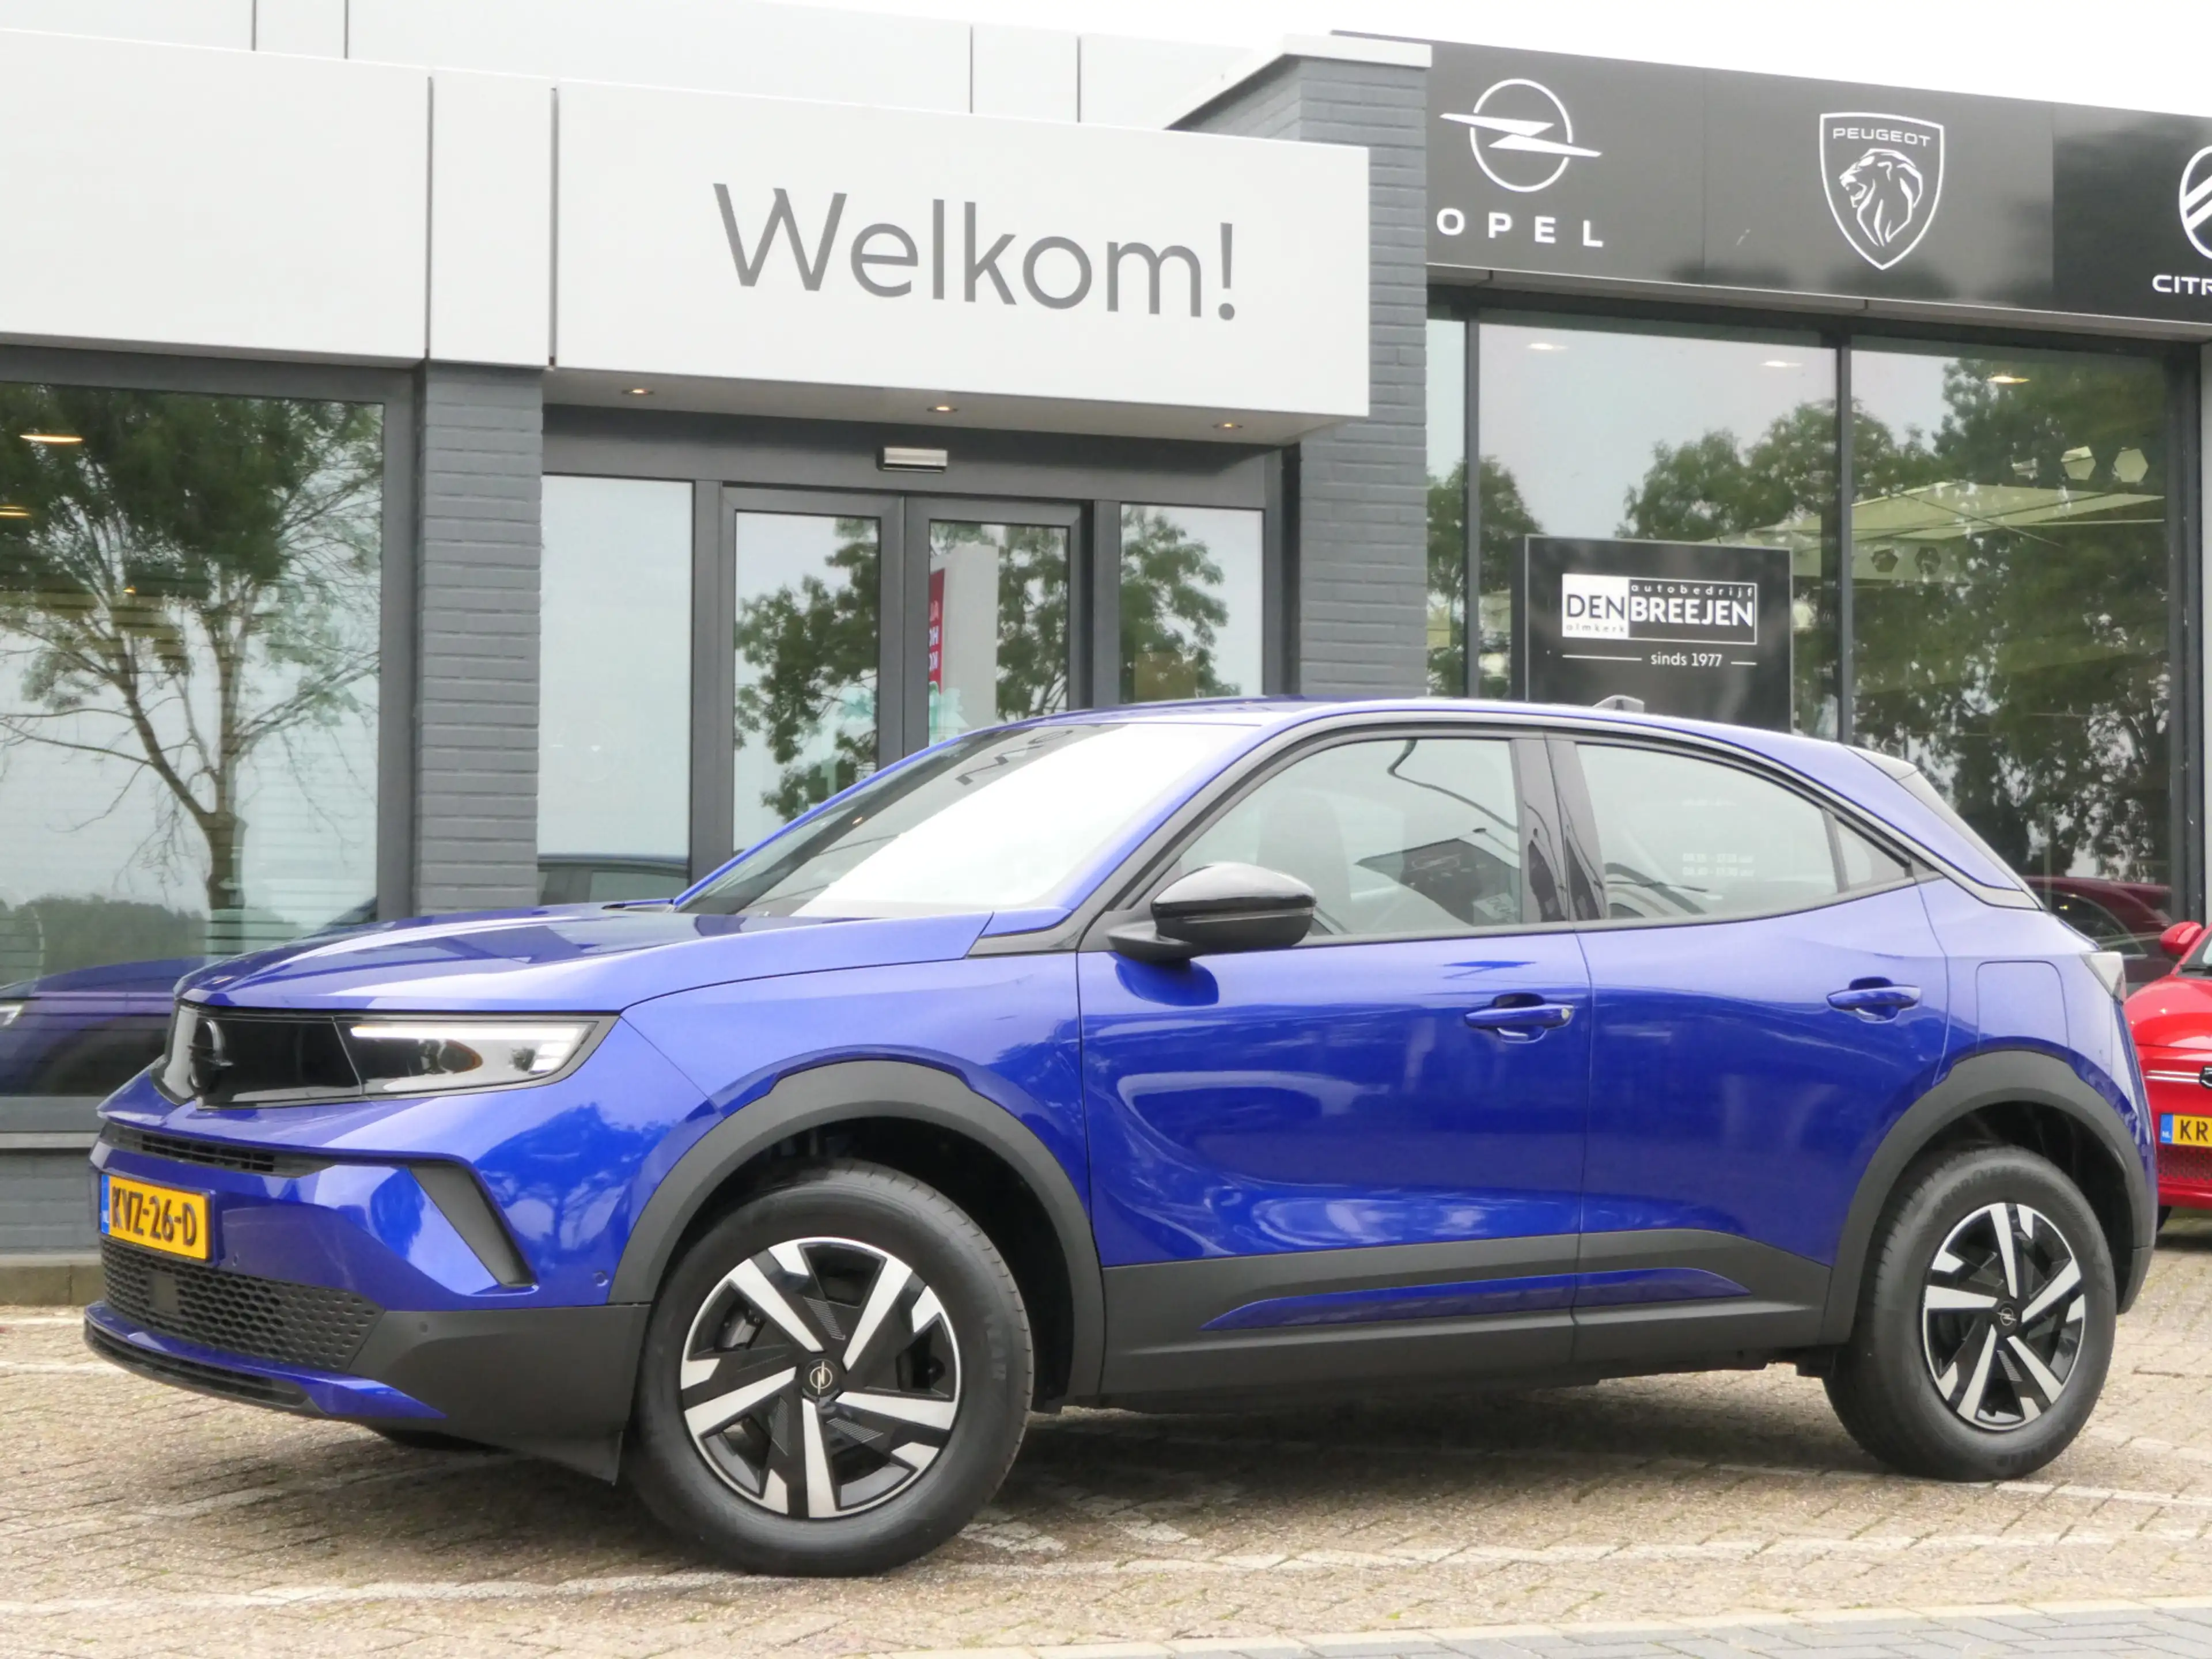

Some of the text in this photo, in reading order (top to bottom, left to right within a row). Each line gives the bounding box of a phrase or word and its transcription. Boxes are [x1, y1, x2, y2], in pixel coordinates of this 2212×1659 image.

[1832, 127, 1931, 147] PEUGEOT
[1436, 207, 1604, 248] OPEL
[713, 183, 1235, 321] Welkom!
[2152, 274, 2212, 296] CITR
[1631, 584, 1753, 599] autobedrijf
[1567, 594, 1753, 627] DEN BREEJEN
[1650, 652, 1722, 667] sinds 1977
[112, 1186, 196, 1247] KVZ-26-D
